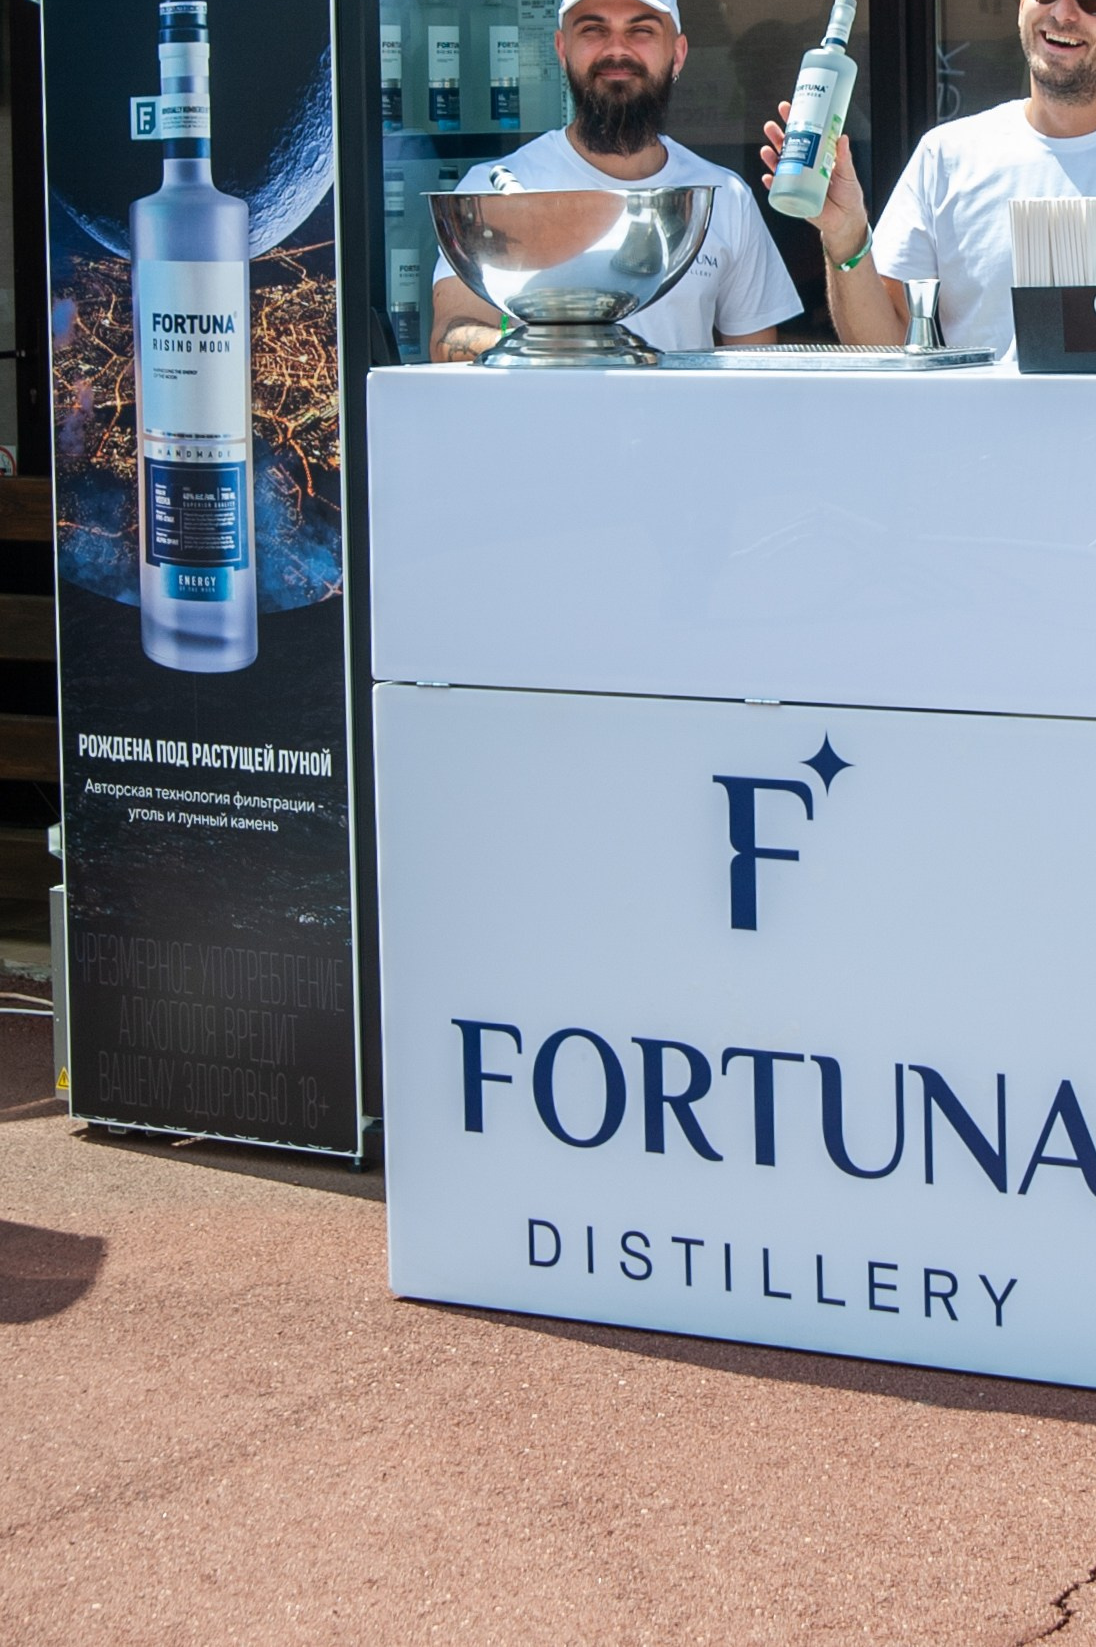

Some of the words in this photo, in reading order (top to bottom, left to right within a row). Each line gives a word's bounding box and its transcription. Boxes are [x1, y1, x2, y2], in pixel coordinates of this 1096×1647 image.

[152, 313, 235, 335] FORTUNA
[153, 338, 193, 353] RISING
[199, 340, 230, 353] MOON
[179, 574, 216, 587] ENERGY
[78, 733, 153, 763] РОЖДЕНА
[156, 739, 189, 770] ПОД
[191, 742, 275, 775] РАСТУЩЕЙ
[278, 746, 332, 778] ЛУНОЙ
[84, 777, 153, 800] Авторская
[155, 786, 231, 808] технология
[232, 791, 316, 814] фильтрации
[128, 806, 164, 827] уголь
[166, 812, 175, 824] и
[178, 811, 228, 830] лунный
[230, 817, 279, 833] камень
[74, 931, 193, 995] ЧРЕЗМЕРНОЕ
[198, 945, 345, 1013] УПОТРЕБЛЕНИЕ
[118, 994, 217, 1056] АЛКОГОЛЯ
[224, 1006, 298, 1069] ВРЕДИТ
[98, 1050, 176, 1110] ВАШЕМУ
[298, 1076, 330, 1129] 18+
[527, 1217, 1019, 1328] DISTILLERY
